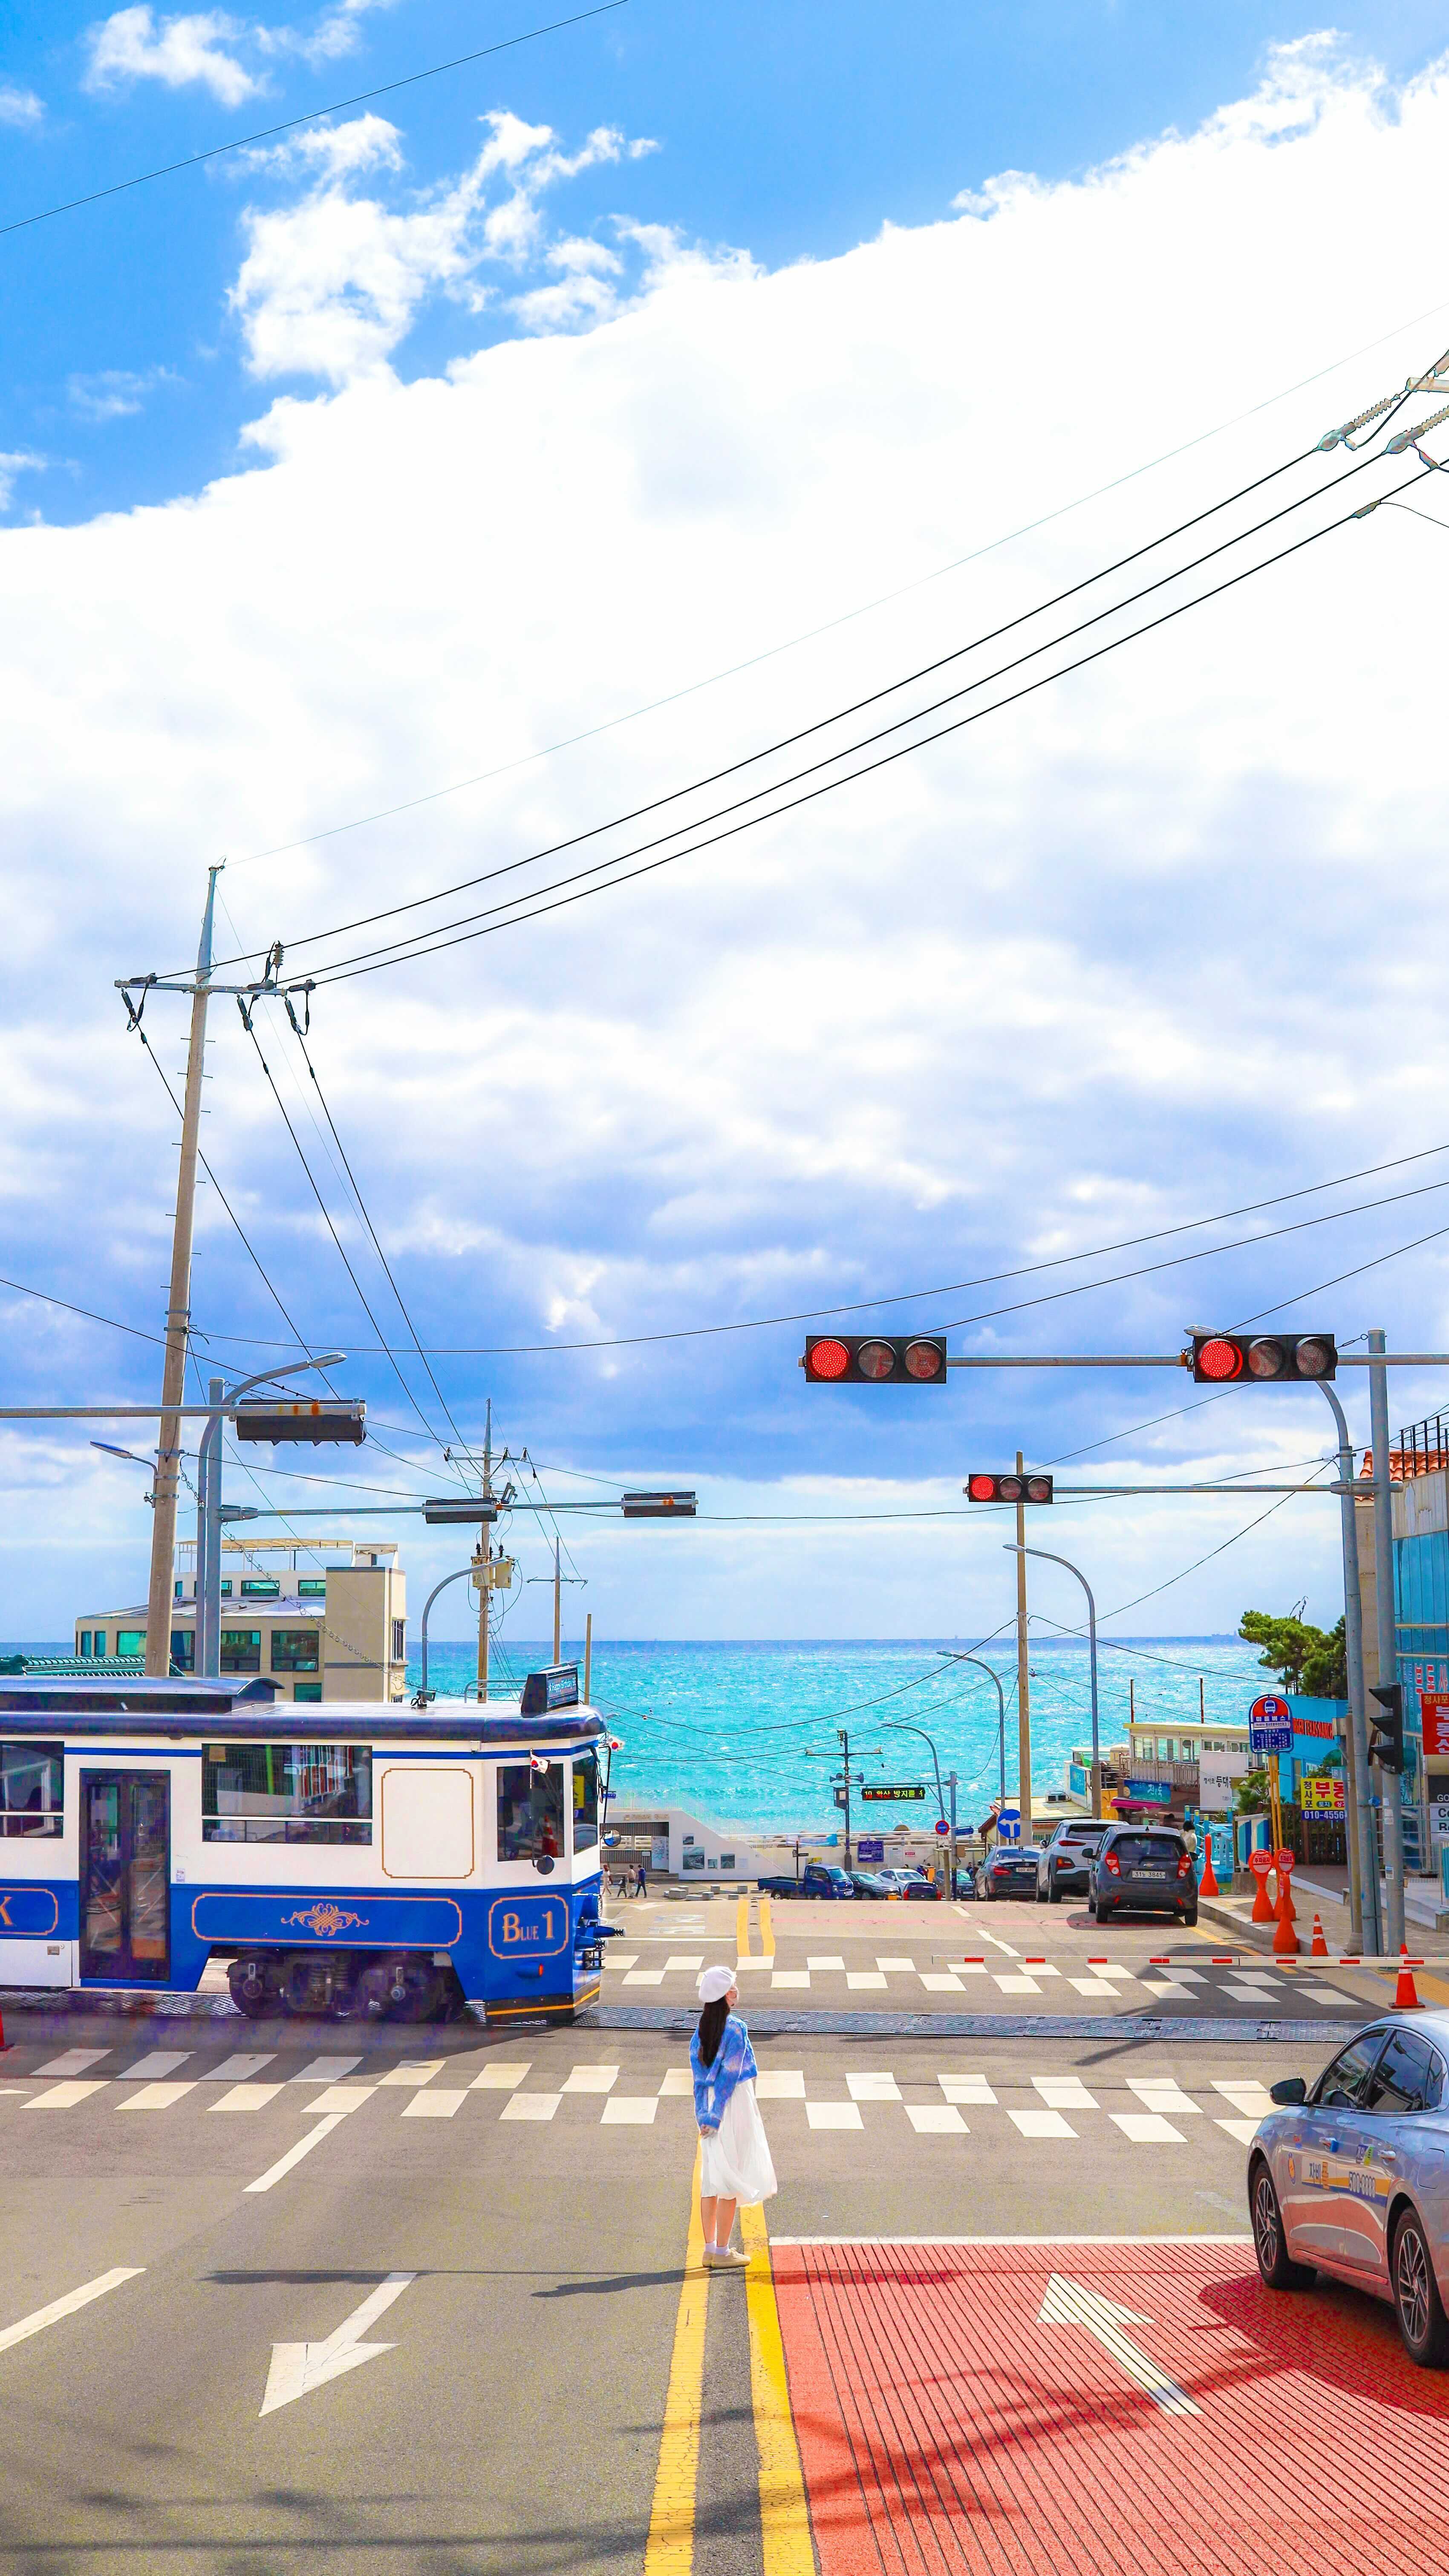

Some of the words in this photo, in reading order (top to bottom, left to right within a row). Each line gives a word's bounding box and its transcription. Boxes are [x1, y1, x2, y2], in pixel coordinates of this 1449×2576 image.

[1216, 1775, 1231, 1788] 등대
[1303, 1781, 1313, 1808] 청사포
[1439, 1822, 1449, 1831] B
[542, 1911, 554, 1940] 1
[1349, 2171, 1376, 2198] 500-8888
